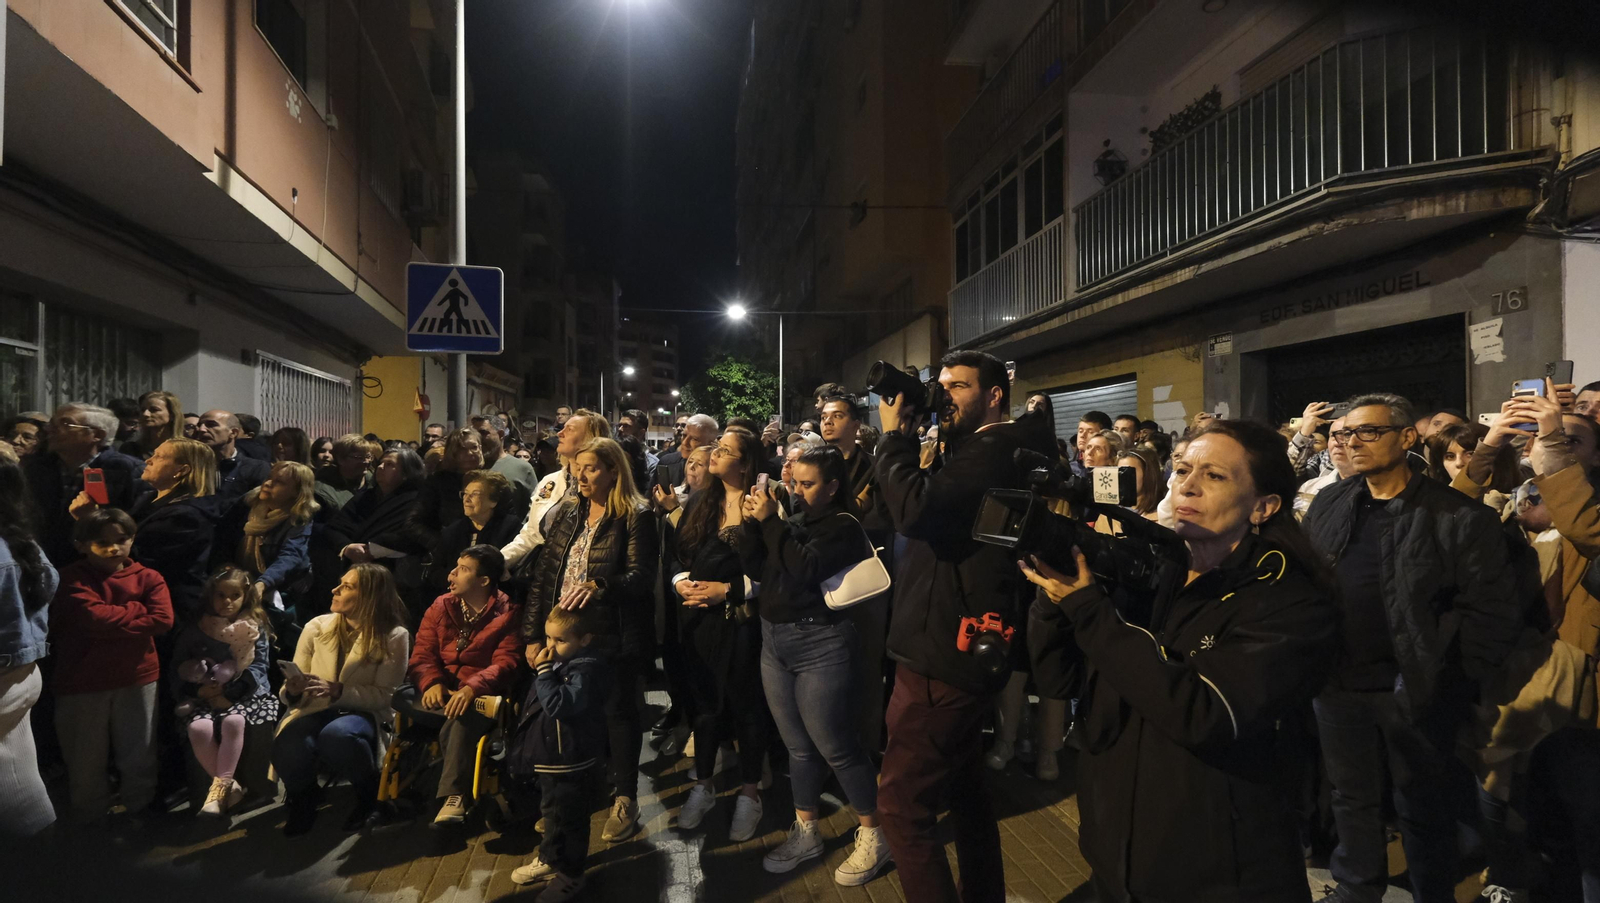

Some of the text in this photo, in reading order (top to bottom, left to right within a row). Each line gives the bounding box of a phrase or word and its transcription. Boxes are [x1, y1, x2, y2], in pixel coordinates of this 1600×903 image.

[1301, 291, 1340, 314] SAN
[1346, 271, 1431, 304] MIGUEL
[1491, 289, 1522, 313] 76
